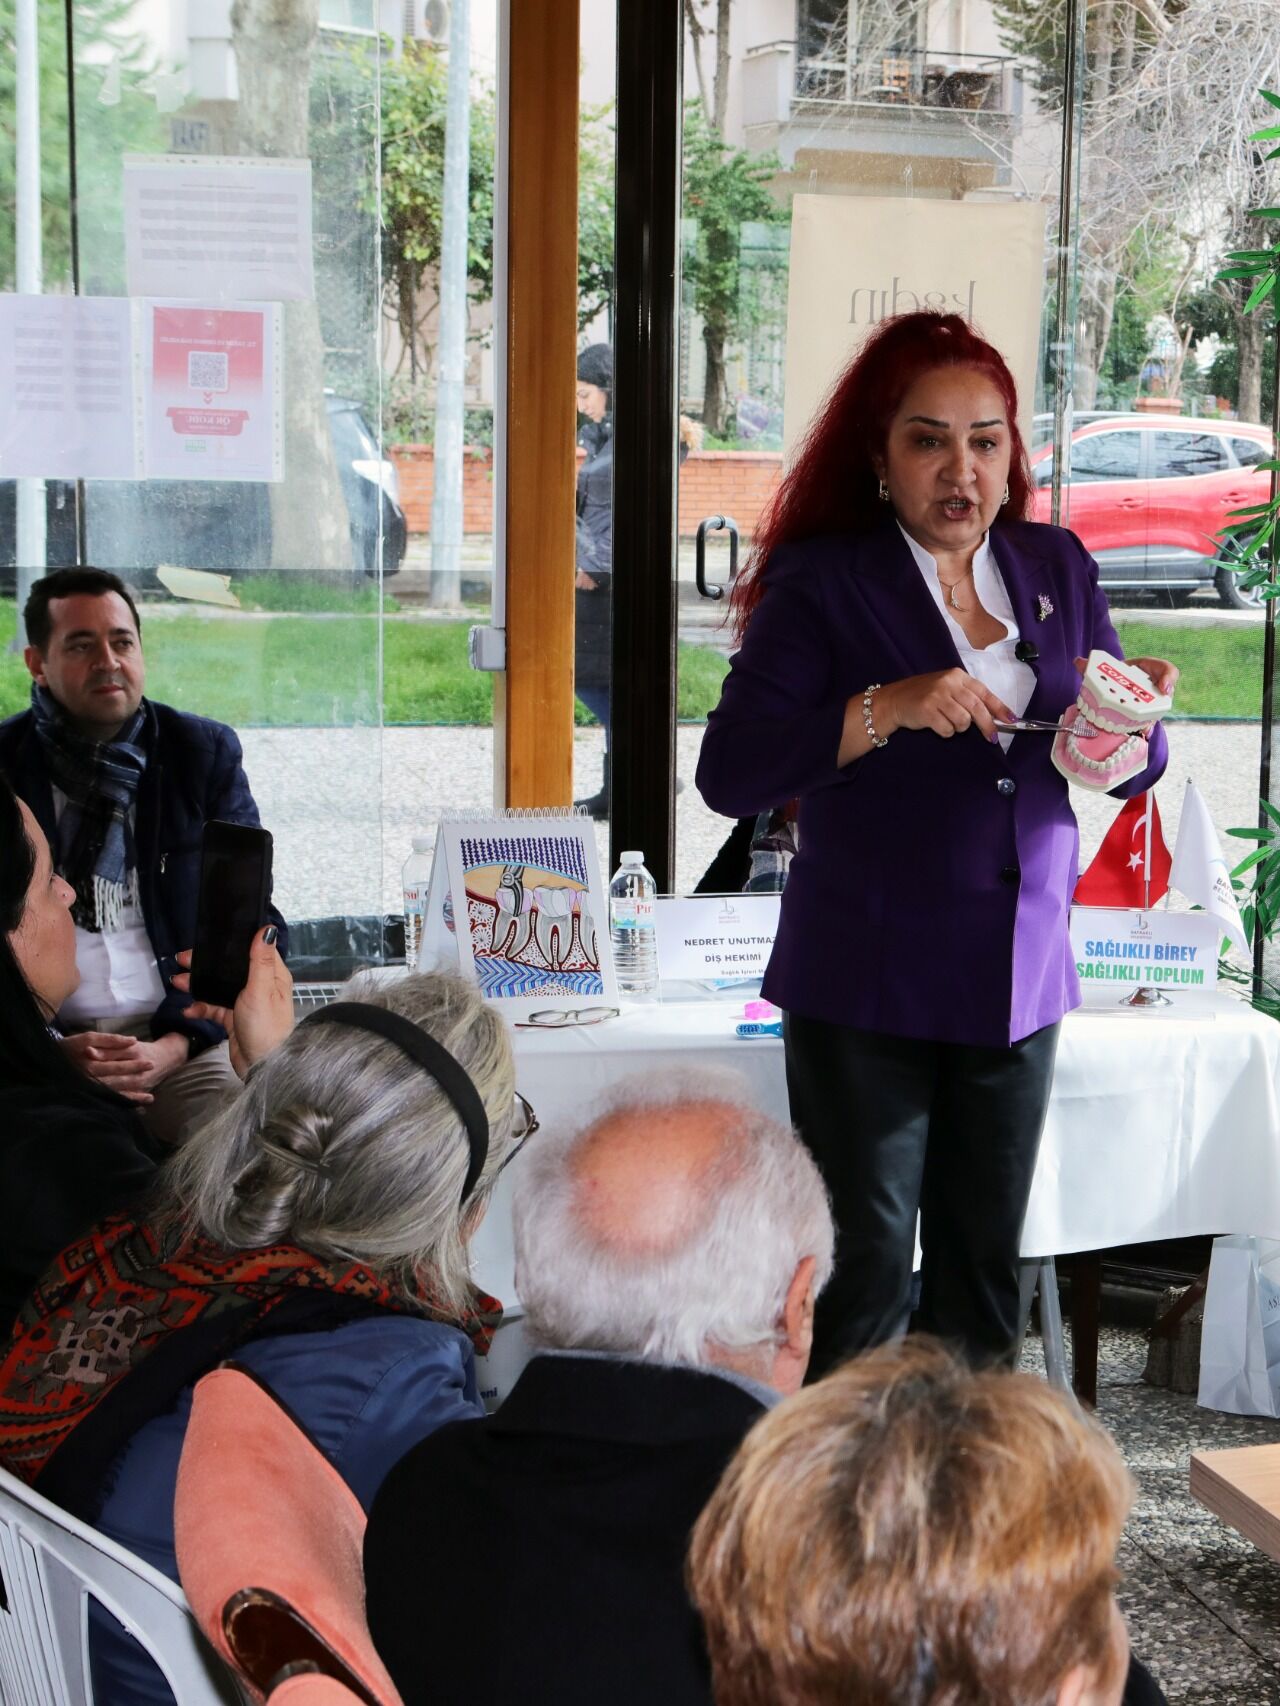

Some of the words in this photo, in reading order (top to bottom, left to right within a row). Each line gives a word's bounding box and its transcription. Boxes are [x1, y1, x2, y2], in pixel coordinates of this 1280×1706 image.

[684, 937, 725, 946] NEDRET
[704, 953, 722, 963] DİŞ
[725, 952, 761, 962] HEKİMİ
[1085, 939, 1150, 960] SAĞLIKLI
[1154, 942, 1198, 962] BİREY
[1076, 960, 1140, 981] SAĞLIKLI
[1144, 966, 1204, 985] TOPLUM
